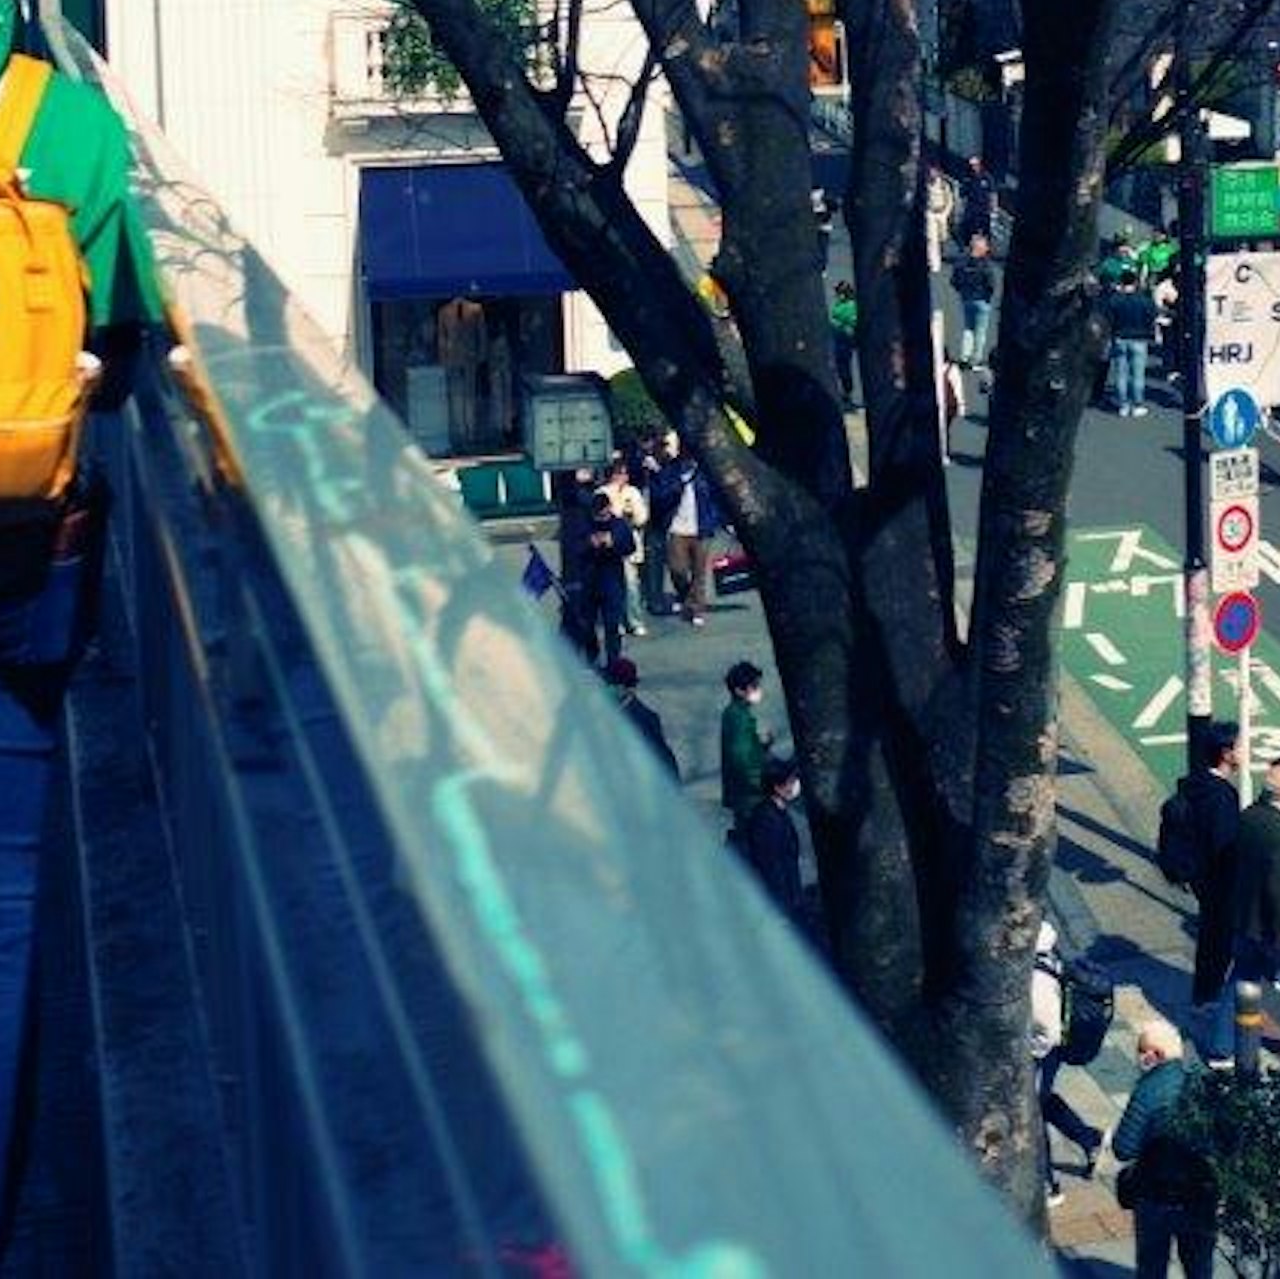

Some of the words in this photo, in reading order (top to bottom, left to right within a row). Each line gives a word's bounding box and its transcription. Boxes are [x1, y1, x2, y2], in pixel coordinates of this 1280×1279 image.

[1234, 264, 1251, 284] C
[1211, 295, 1228, 316] T
[1209, 342, 1254, 364] HRJ
